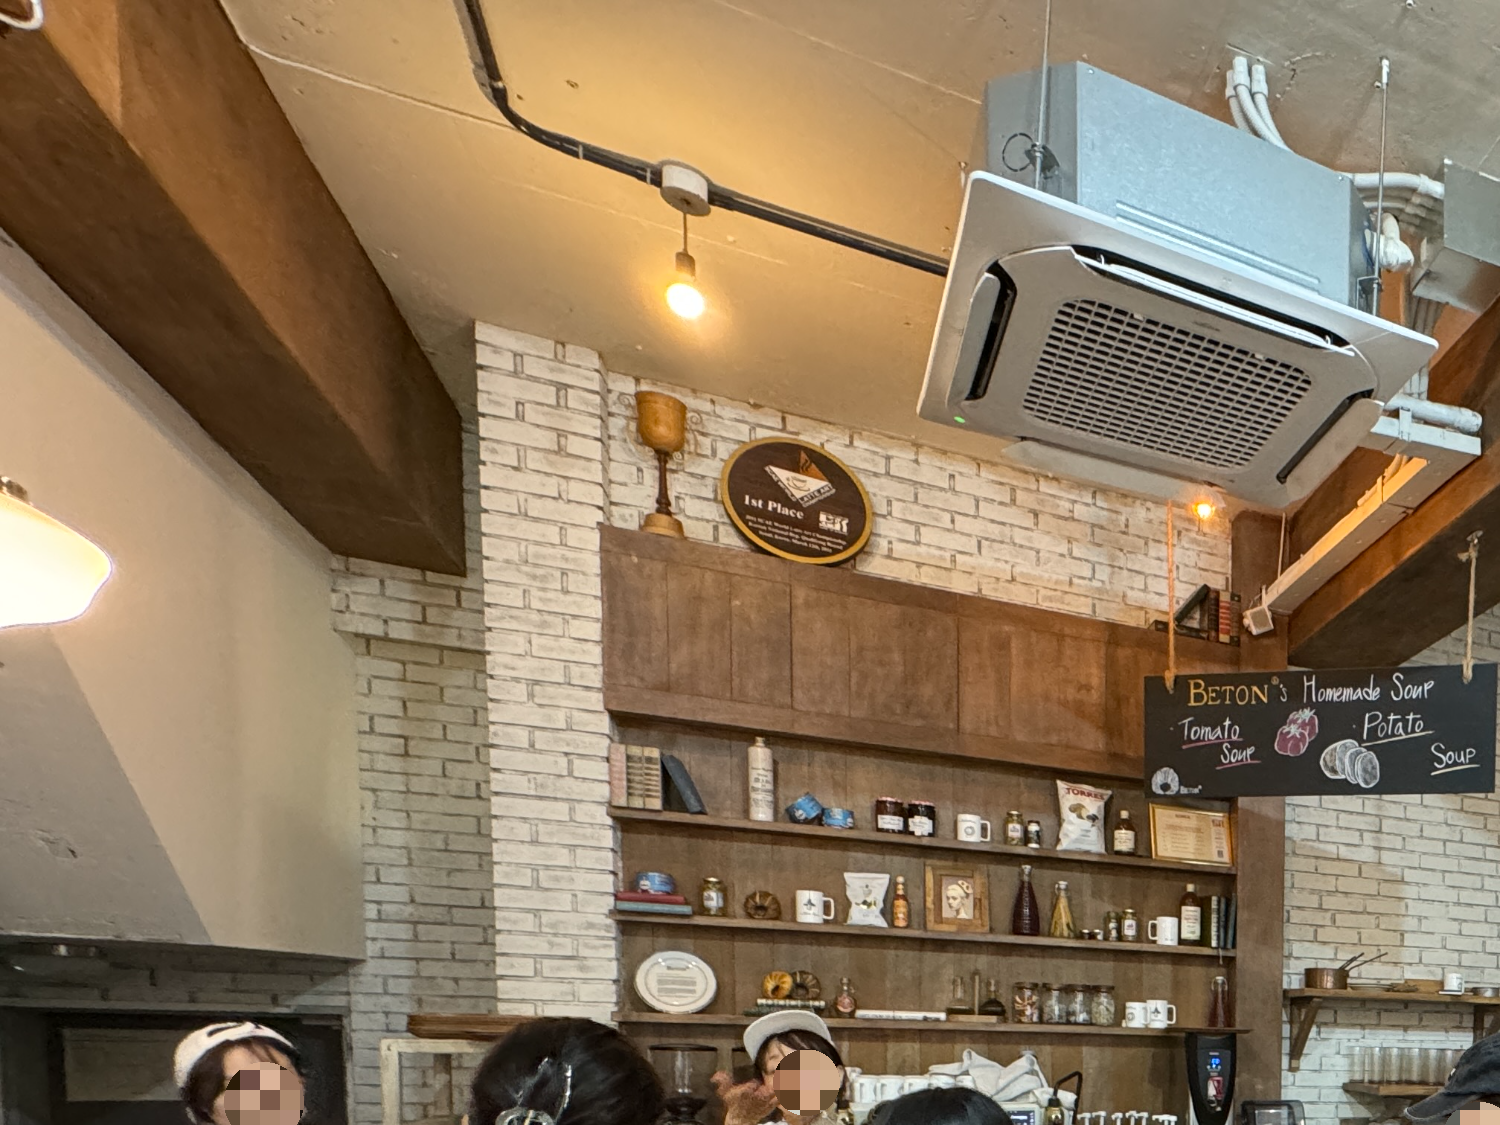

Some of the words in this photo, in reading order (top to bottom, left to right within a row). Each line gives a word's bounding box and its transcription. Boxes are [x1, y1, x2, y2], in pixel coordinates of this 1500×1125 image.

[744, 494, 763, 509] 1st
[768, 501, 804, 520] Place
[1303, 675, 1381, 703] Homemade
[1391, 672, 1435, 702] Soup
[1179, 716, 1240, 742] Tomato
[1363, 711, 1424, 741] Potato
[1220, 742, 1256, 764] Soup
[1431, 742, 1476, 769] Soup
[1065, 787, 1106, 801] TORRES
